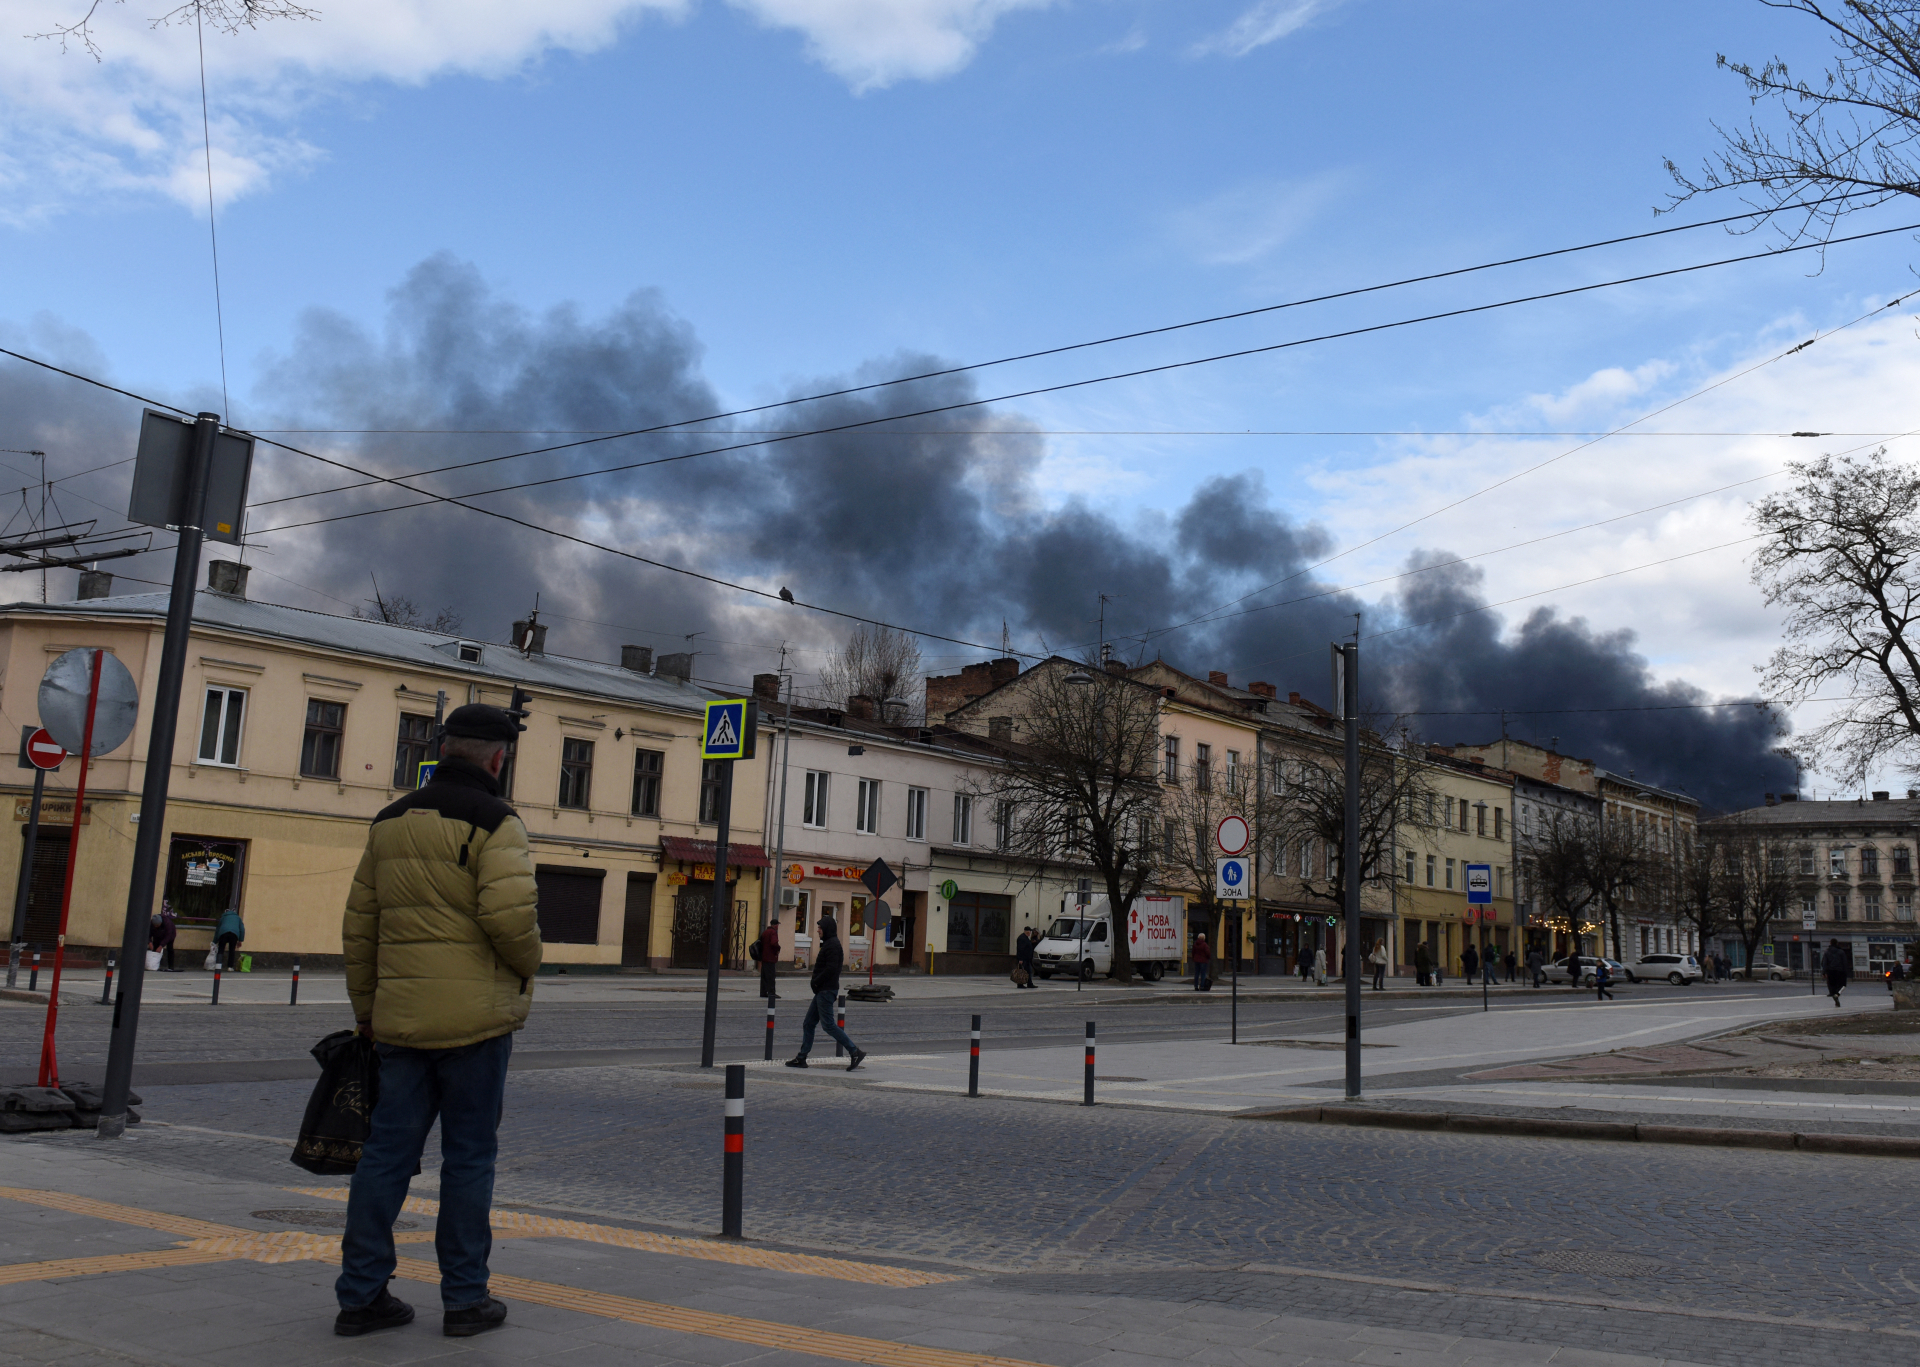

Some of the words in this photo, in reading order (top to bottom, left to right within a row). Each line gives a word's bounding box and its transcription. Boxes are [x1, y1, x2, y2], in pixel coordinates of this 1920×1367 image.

[695, 865, 730, 876] ЧАРА
[1222, 888, 1243, 897] ЗОНА
[1147, 914, 1170, 926] НОВА
[1147, 928, 1177, 940] ПОШТА
